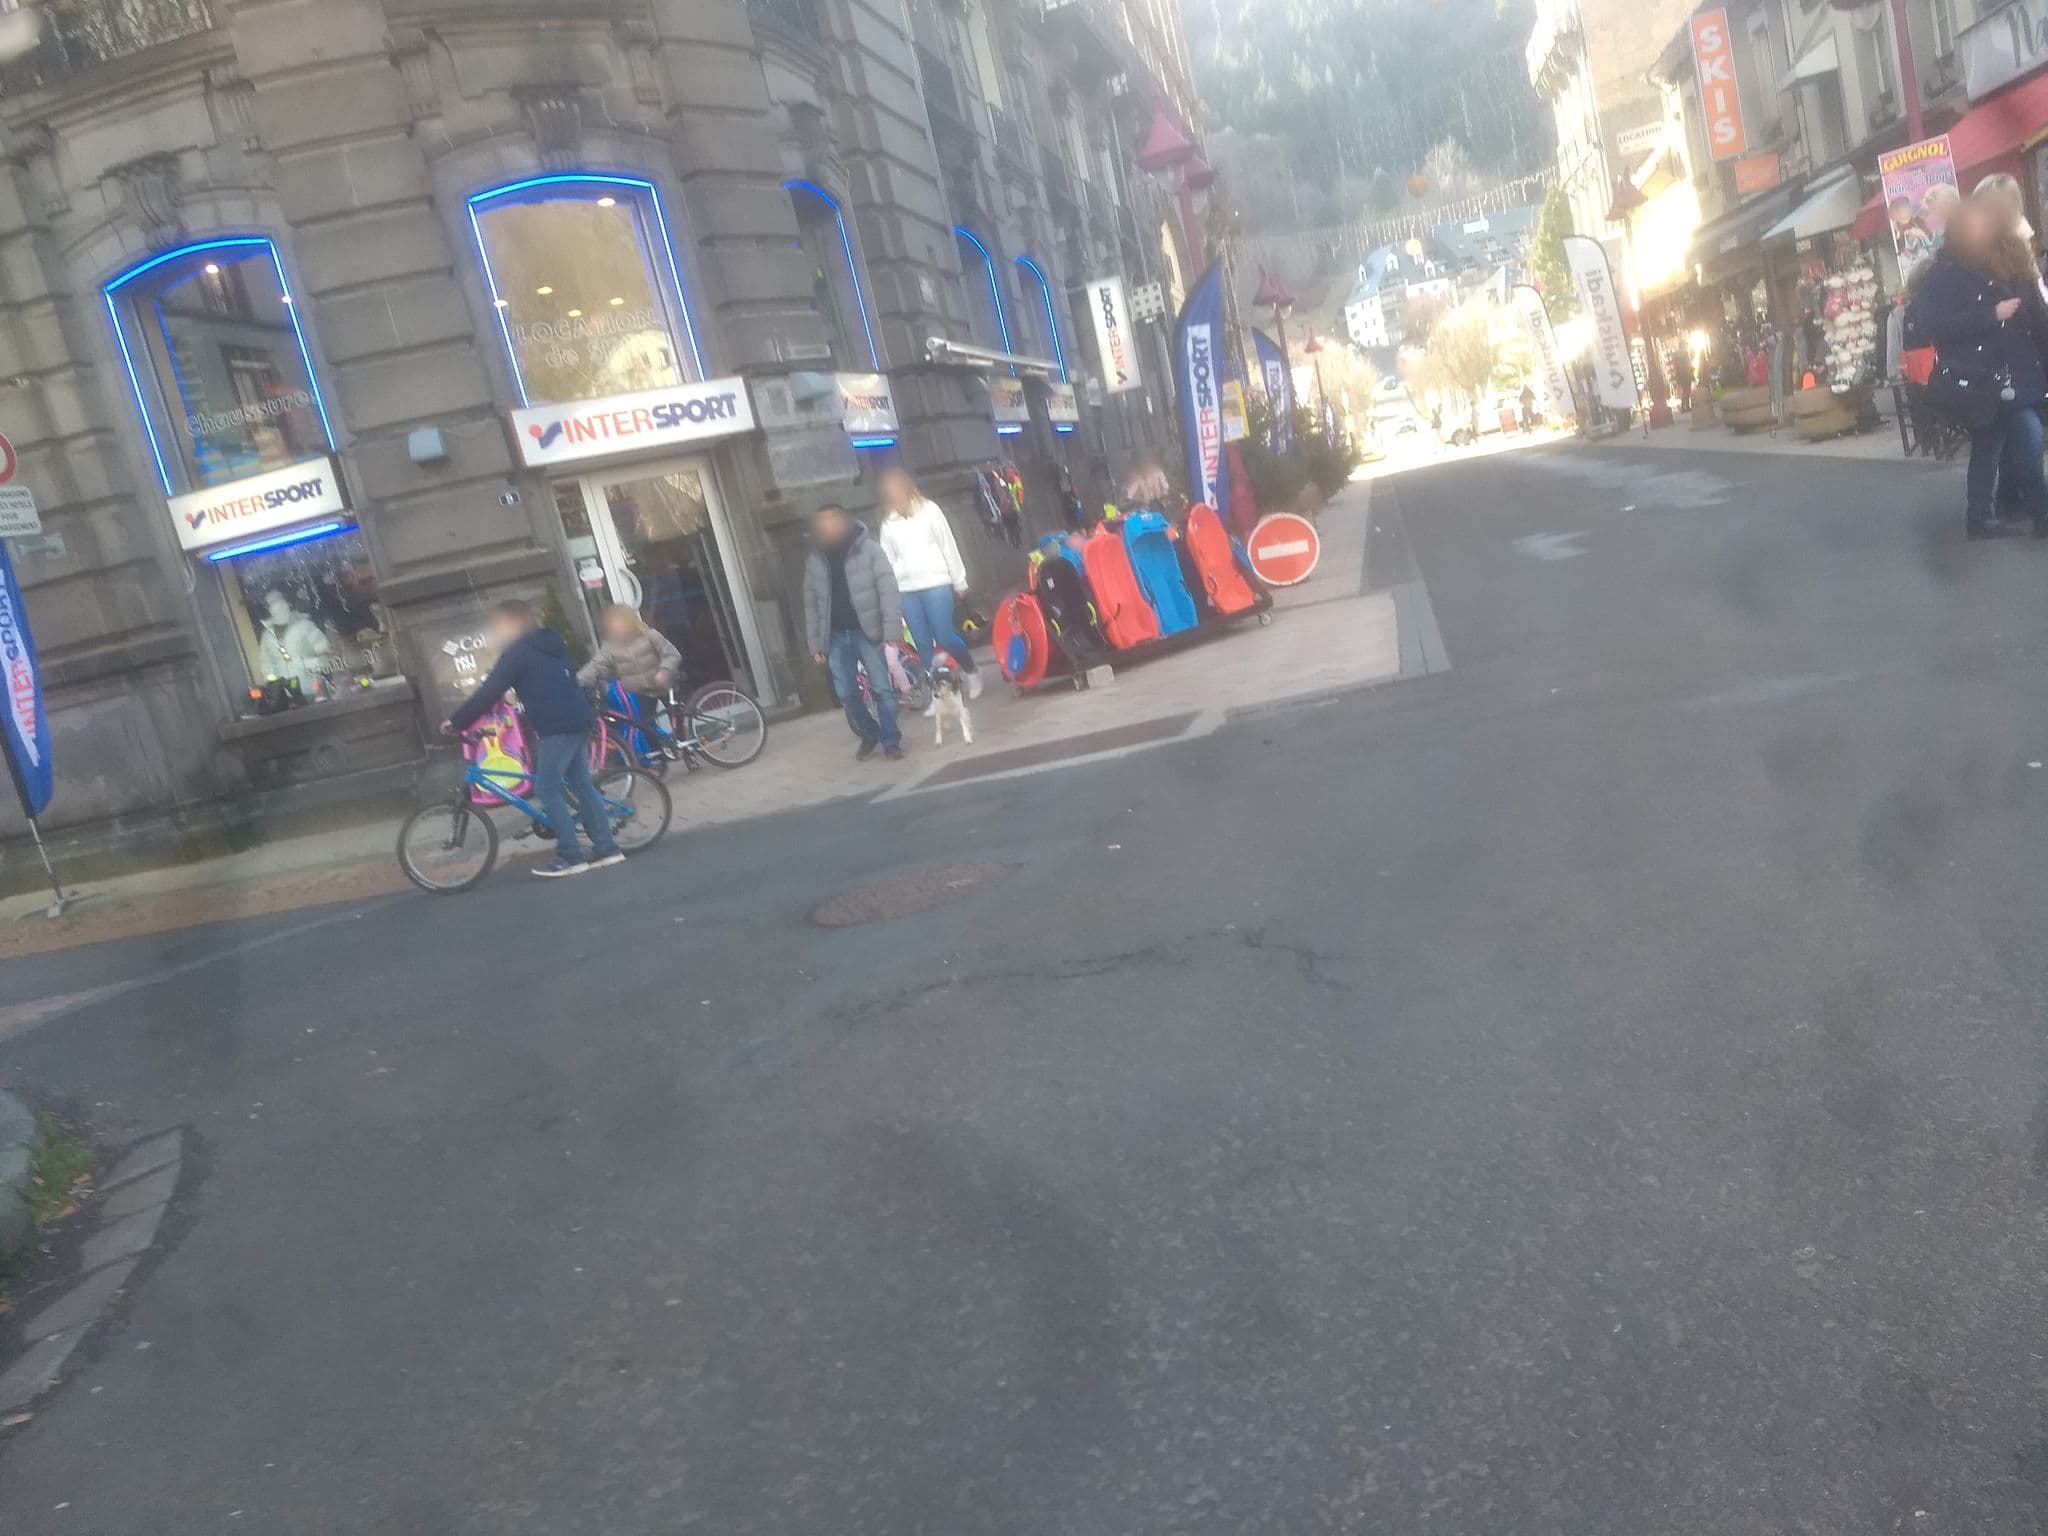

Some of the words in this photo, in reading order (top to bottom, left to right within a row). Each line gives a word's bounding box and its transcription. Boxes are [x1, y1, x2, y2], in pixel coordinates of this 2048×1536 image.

[1700, 25, 1736, 144] SKIS
[1884, 142, 1947, 173] GUIGNOL
[516, 306, 658, 346] LOCATION
[1100, 286, 1126, 370] INTERSPORT
[563, 392, 737, 444] INTERSPORT
[1192, 335, 1219, 481] INTERSPORT
[207, 476, 325, 526] INTERSPORT
